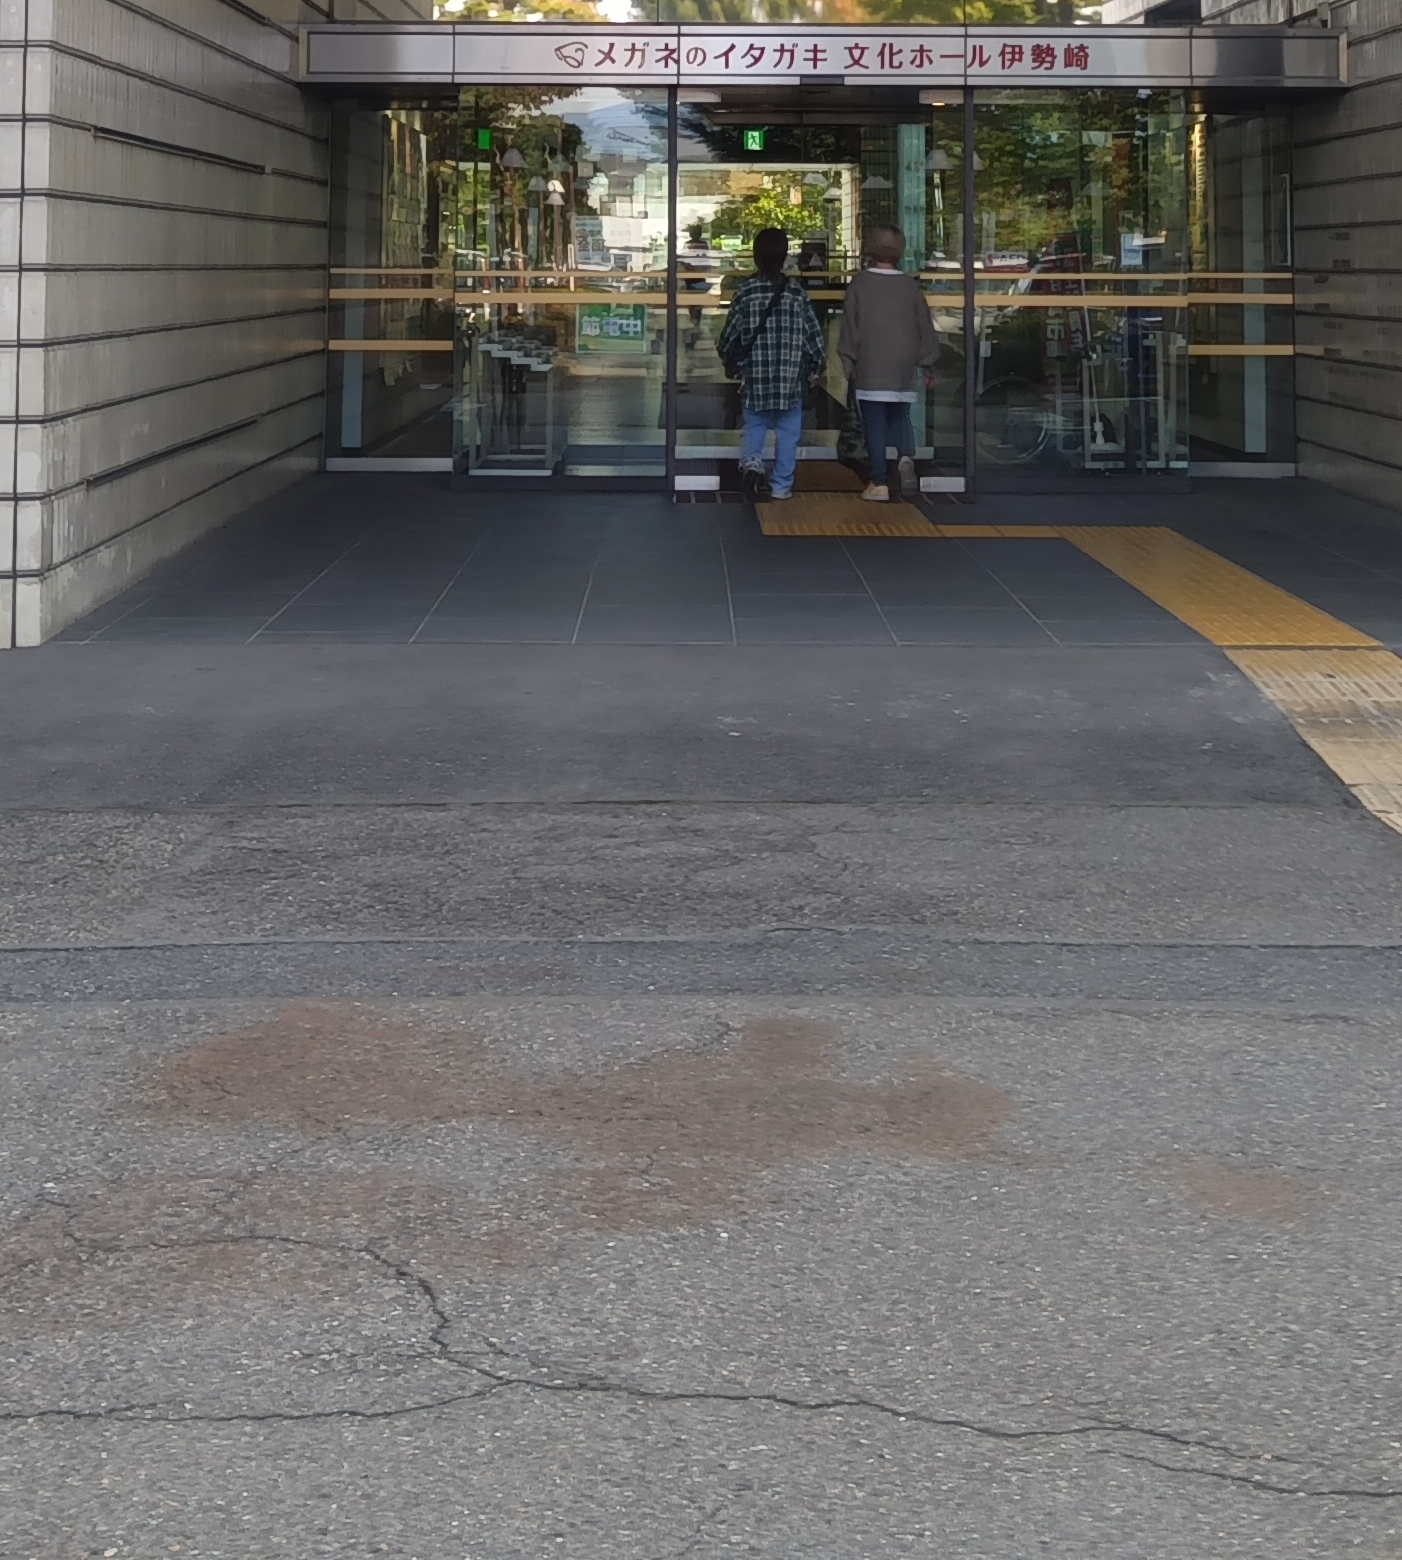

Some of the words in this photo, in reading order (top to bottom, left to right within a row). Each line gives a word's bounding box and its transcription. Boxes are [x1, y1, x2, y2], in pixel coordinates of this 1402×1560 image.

[594, 42, 828, 70] メガネのイタガキ
[844, 42, 1089, 71] 文化ホール伊勢崎
